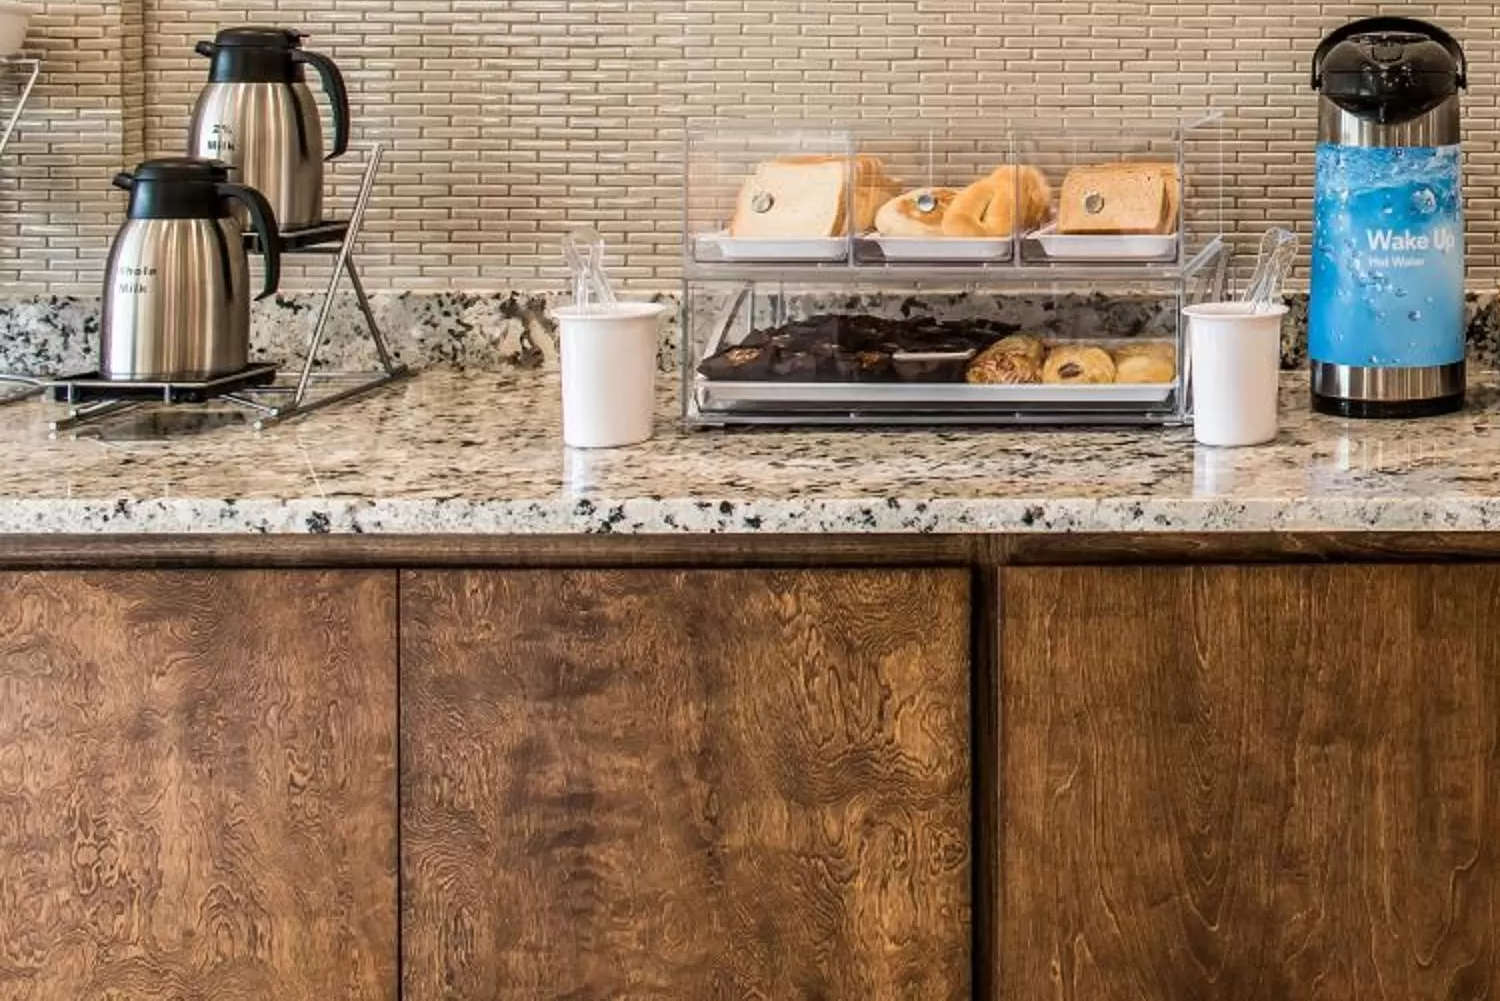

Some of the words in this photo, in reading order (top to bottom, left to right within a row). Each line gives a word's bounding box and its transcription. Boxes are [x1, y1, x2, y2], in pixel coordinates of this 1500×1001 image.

[1366, 228, 1429, 251] Wake
[1433, 227, 1456, 253] Up
[119, 282, 148, 294] Milk
